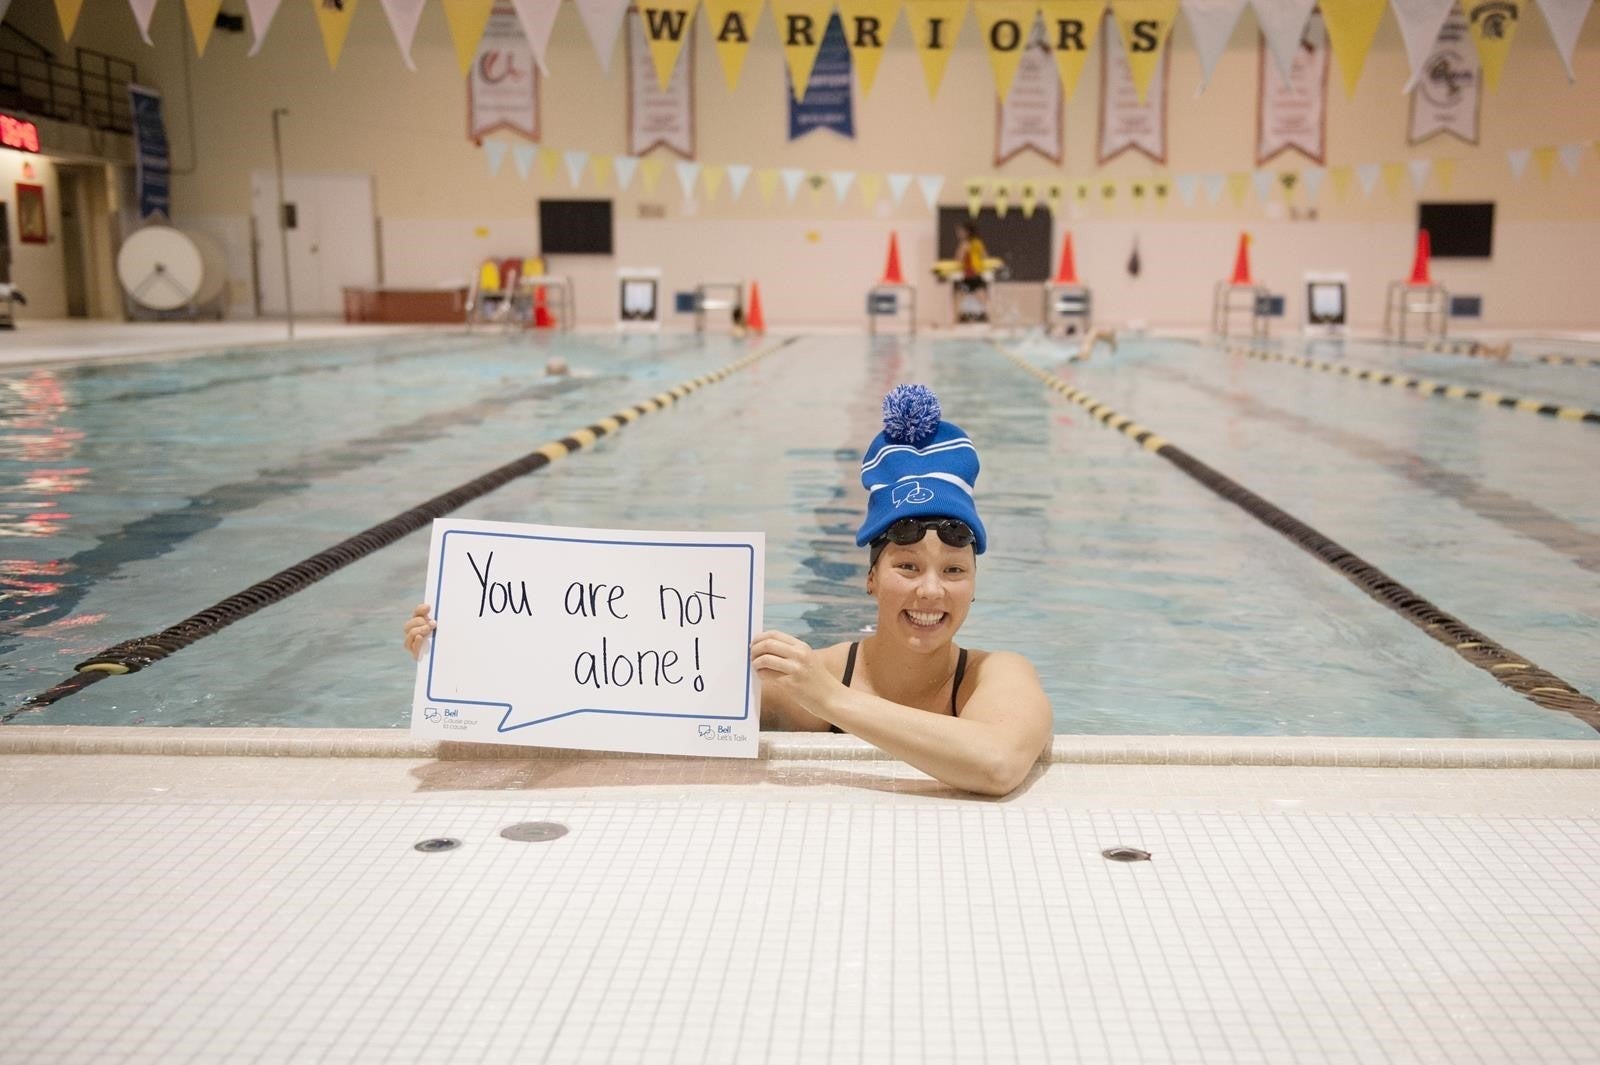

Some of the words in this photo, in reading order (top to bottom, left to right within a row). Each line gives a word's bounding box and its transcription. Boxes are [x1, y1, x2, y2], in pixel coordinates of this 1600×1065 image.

[645, 8, 1159, 53] WARRIORS
[467, 551, 533, 618] You
[564, 581, 629, 620] are
[659, 572, 727, 628] not
[574, 636, 705, 693] alone!
[444, 708, 459, 717] Bell
[717, 725, 732, 733] Bell
[717, 733, 733, 741] Let's
[733, 734, 748, 742] Talk
